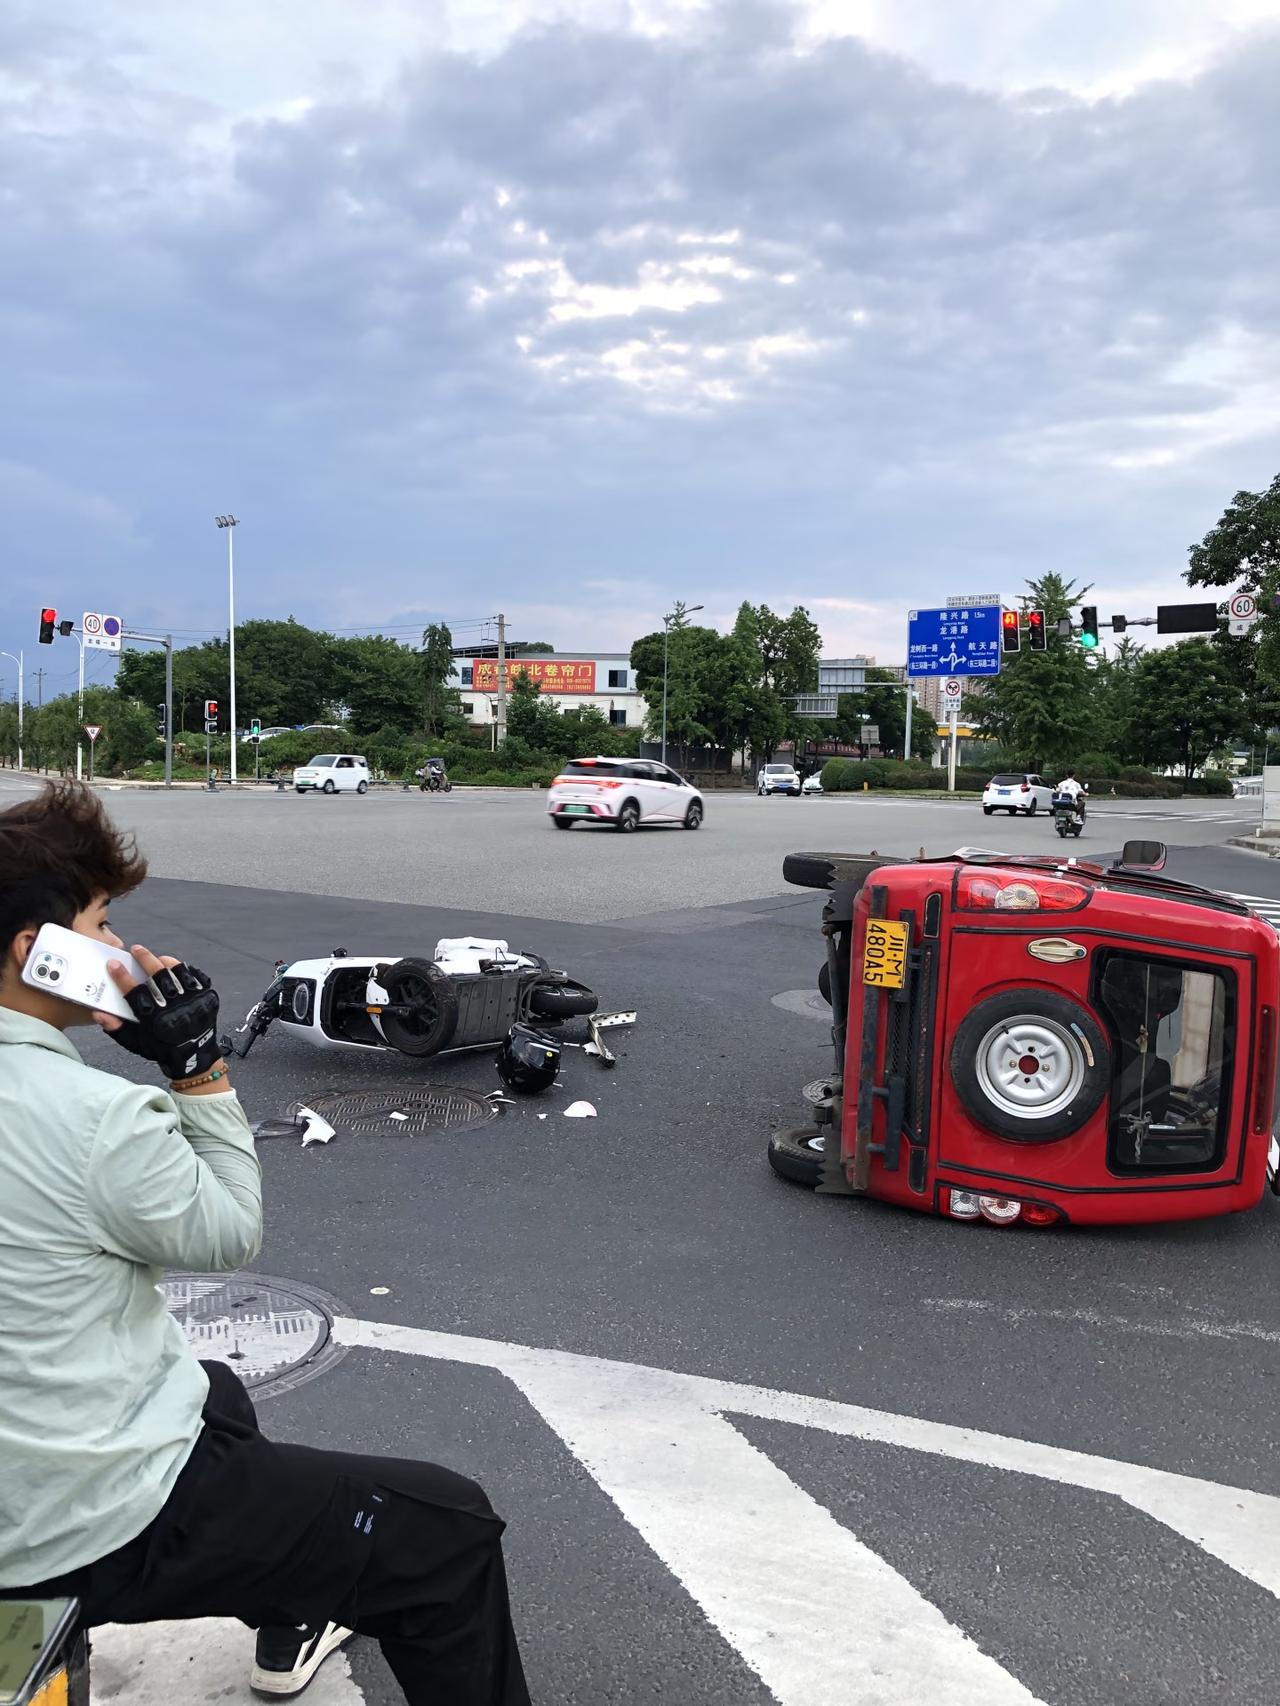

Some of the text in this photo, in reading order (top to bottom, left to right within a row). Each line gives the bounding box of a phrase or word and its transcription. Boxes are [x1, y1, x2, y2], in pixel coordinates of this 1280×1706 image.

[1236, 599, 1250, 613] 60
[940, 611, 969, 621] 隆兴路
[88, 619, 97, 630] 40
[940, 625, 969, 635] 龙港路
[968, 641, 998, 651] 航天路
[865, 924, 887, 982] 480A5
